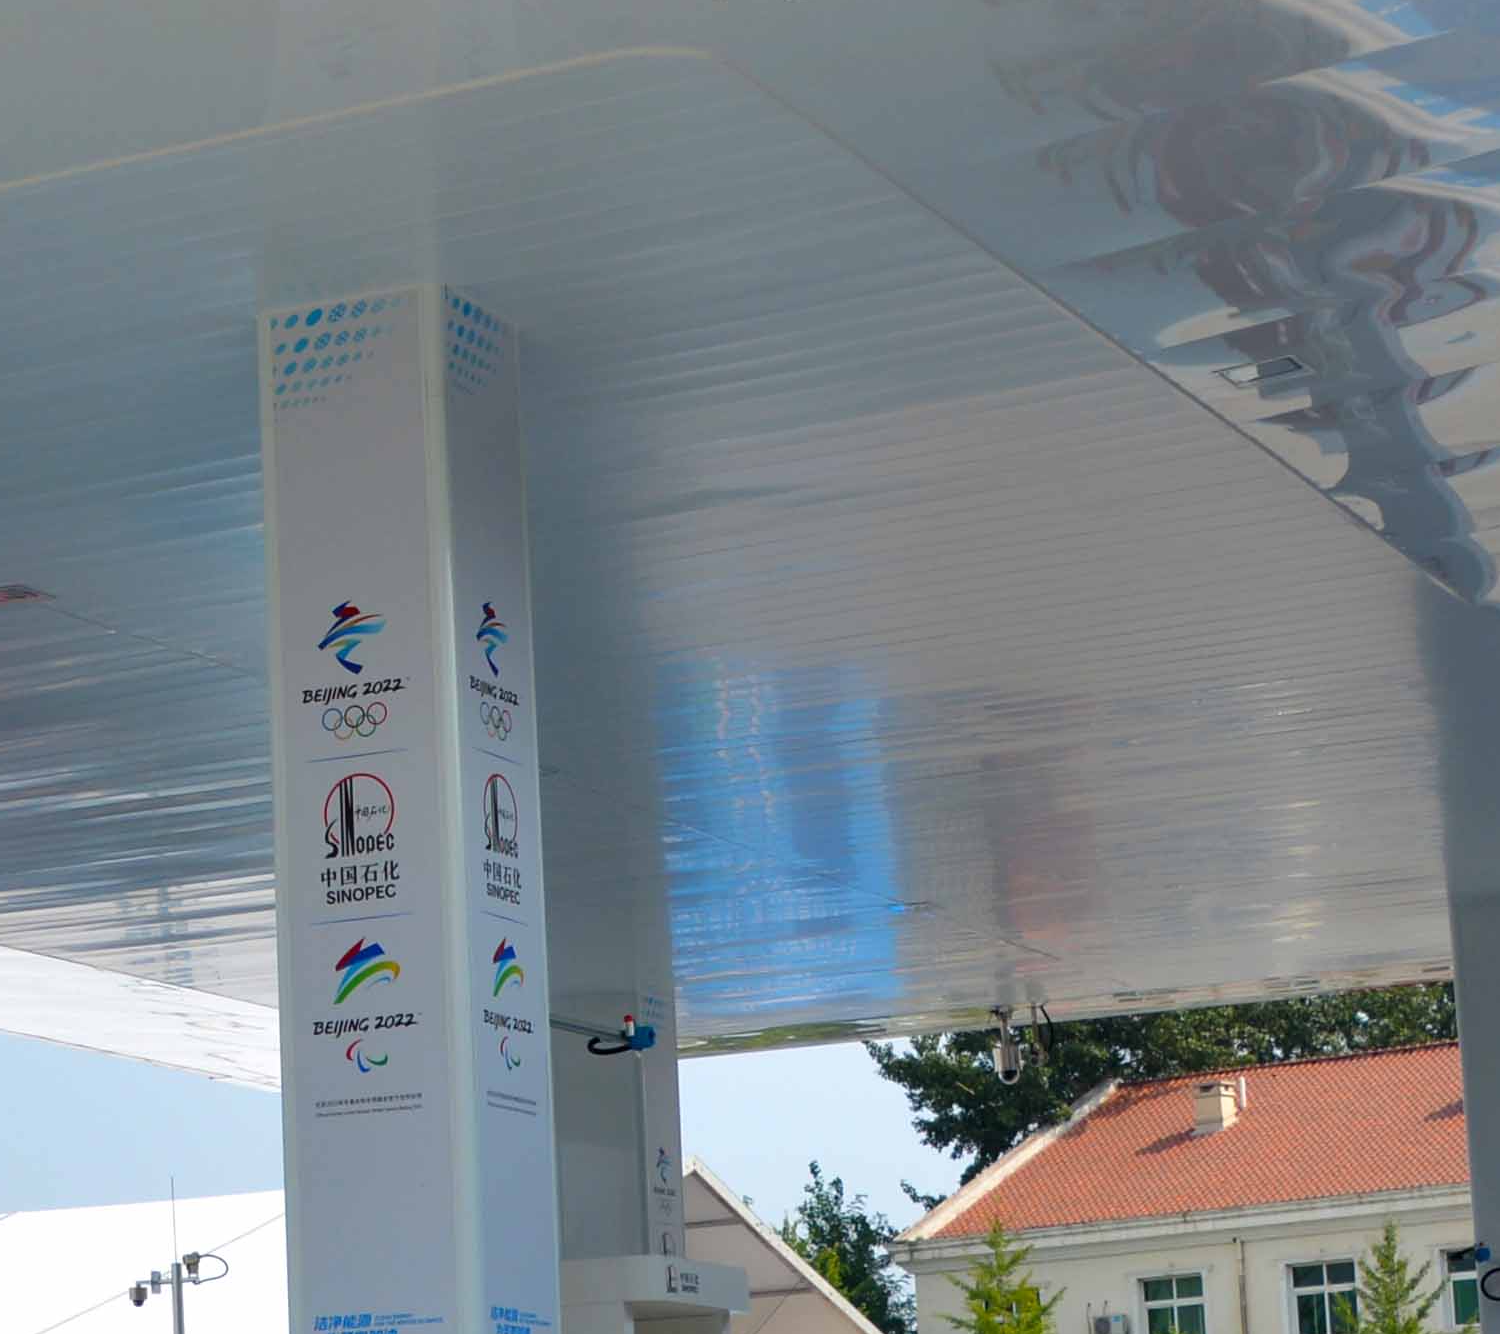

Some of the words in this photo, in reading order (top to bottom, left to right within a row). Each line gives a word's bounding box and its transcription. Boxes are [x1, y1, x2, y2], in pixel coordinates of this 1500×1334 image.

[302, 683, 358, 705] BEIJING
[362, 677, 406, 696] 2022
[320, 860, 400, 888] 中国石化
[483, 858, 522, 889] 中国石化
[326, 884, 397, 905] SINOPEC
[486, 882, 520, 906] SINOPEC
[312, 1015, 369, 1037] BEIJING
[374, 1011, 418, 1030] 2022
